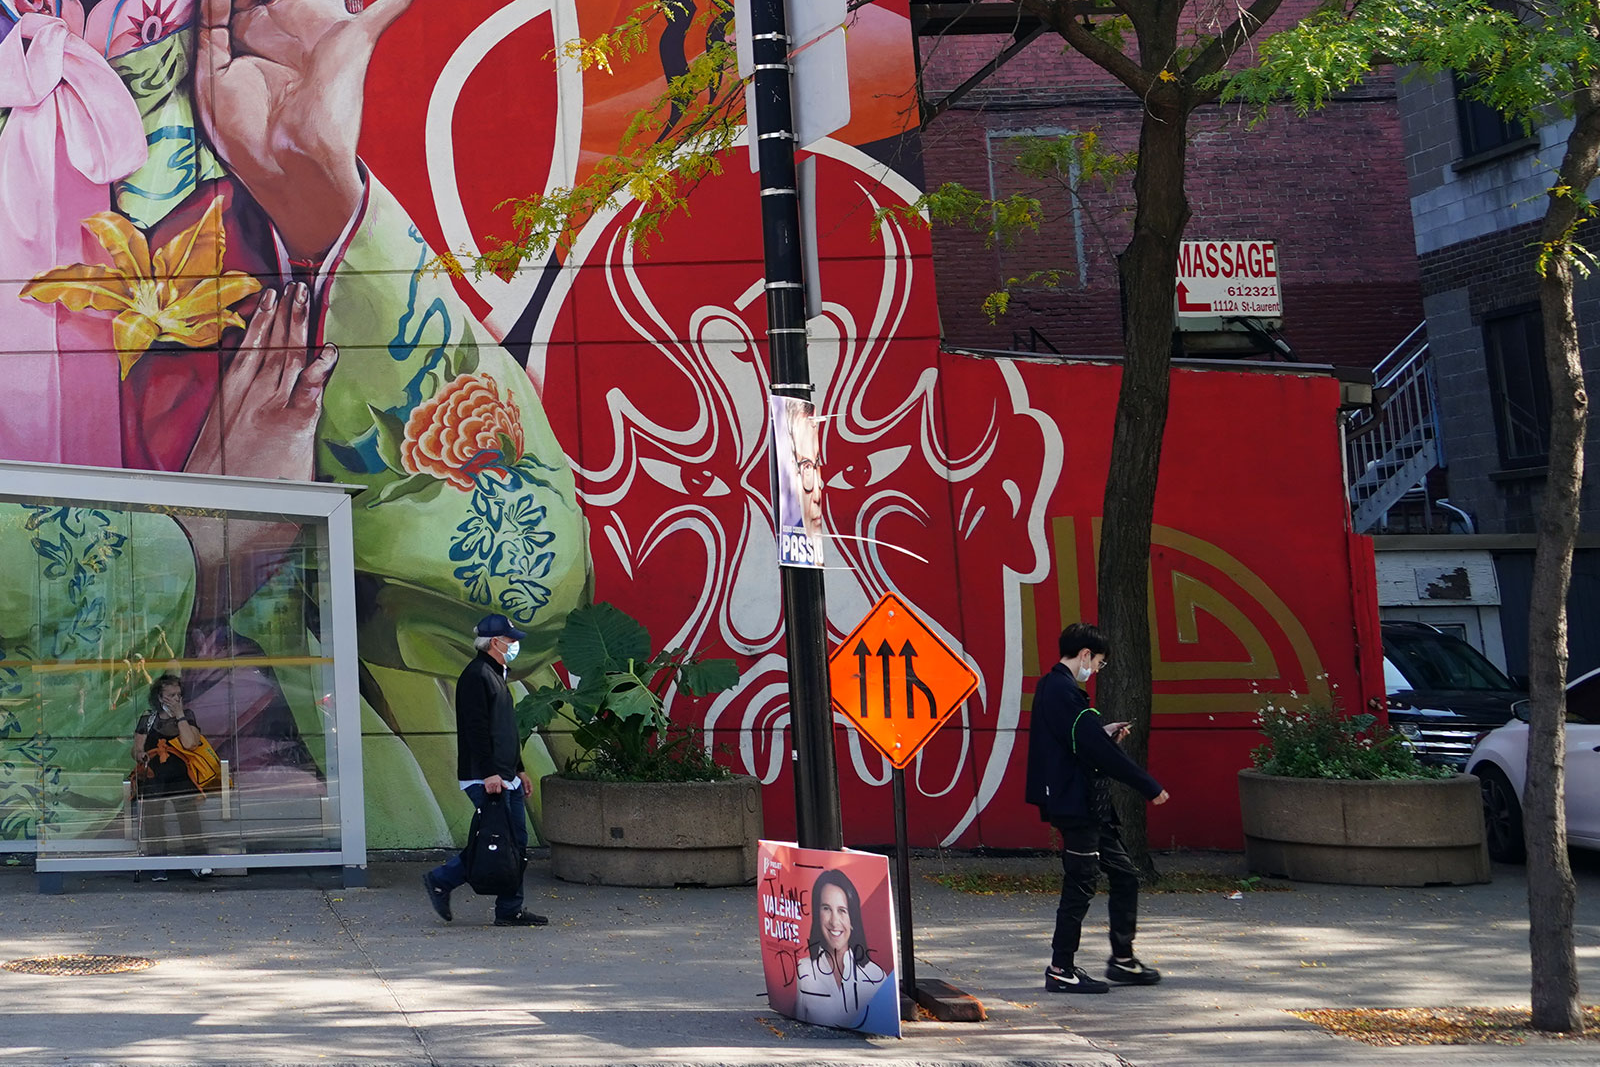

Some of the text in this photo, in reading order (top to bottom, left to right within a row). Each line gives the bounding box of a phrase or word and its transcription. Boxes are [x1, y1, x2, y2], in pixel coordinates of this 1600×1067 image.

[1176, 243, 1277, 278] MASSAGE
[1227, 286, 1277, 296] 612321
[1241, 299, 1281, 312] St-Laurent
